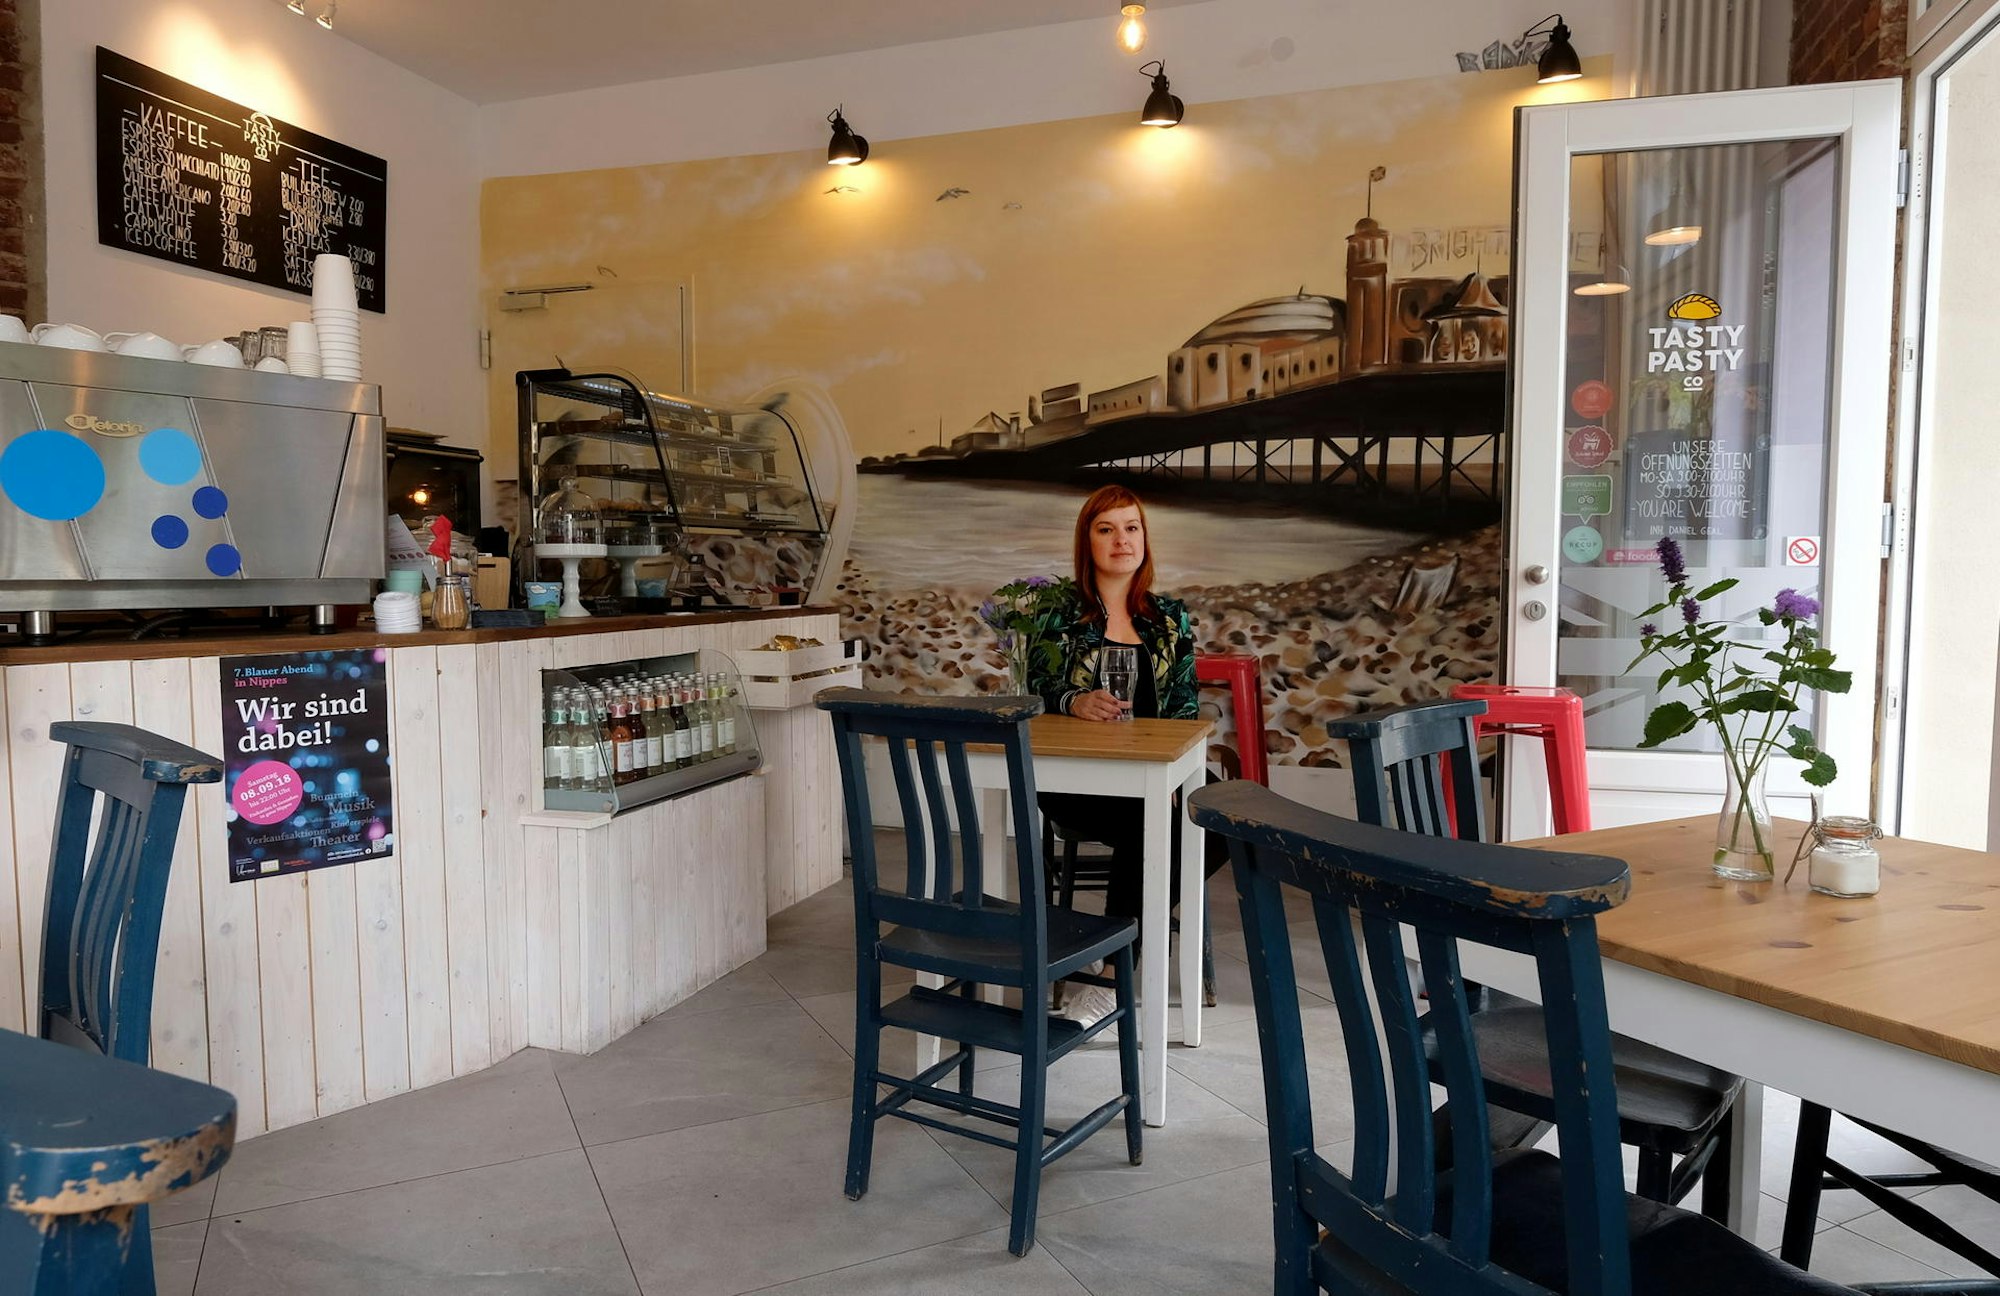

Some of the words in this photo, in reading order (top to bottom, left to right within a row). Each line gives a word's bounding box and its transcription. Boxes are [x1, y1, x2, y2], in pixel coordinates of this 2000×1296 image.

[122, 117, 174, 150] ESPRESSO
[140, 102, 208, 149] KAFFEE
[243, 118, 280, 143] TASTY
[244, 131, 280, 155] PASTY
[122, 135, 175, 168] ESPRESSO
[176, 152, 219, 181] MACCHIATO
[123, 155, 180, 184] AMERICANO
[296, 157, 330, 189] TEE
[123, 167, 159, 193] WHITE
[160, 178, 211, 205] AMERICANO
[124, 197, 152, 219] FLAT
[153, 204, 192, 229] WHITE
[162, 192, 196, 217] LATTE
[125, 212, 192, 241] CAPPUCCINO
[290, 210, 328, 239] DRINKS
[125, 227, 152, 246] ICED
[154, 235, 198, 259] COFFEE
[282, 225, 305, 245] ICED
[305, 232, 331, 253] TEAS
[285, 267, 313, 288] WASS
[1649, 325, 1745, 349] TASTY
[1648, 349, 1744, 373] PASTY
[1683, 376, 1703, 387] CO
[1673, 440, 1726, 453] UNSERE
[1641, 452, 1752, 471] ÖFFNUNGSZEITEN
[1655, 484, 1671, 498] SO
[1661, 500, 1685, 518] ARE
[1669, 525, 1697, 536] DANIEL
[280, 664, 314, 675] Abend
[235, 678, 246, 688] in
[249, 677, 288, 689] Nippes
[235, 696, 297, 723] Wir
[304, 688, 368, 718] sind
[238, 721, 332, 753] dabei!
[240, 774, 292, 801] 08.09.18
[310, 790, 359, 802] Bummeln
[329, 797, 376, 815] Musik
[247, 827, 331, 845] Verkaufsaktionen
[310, 832, 361, 848] Theater
